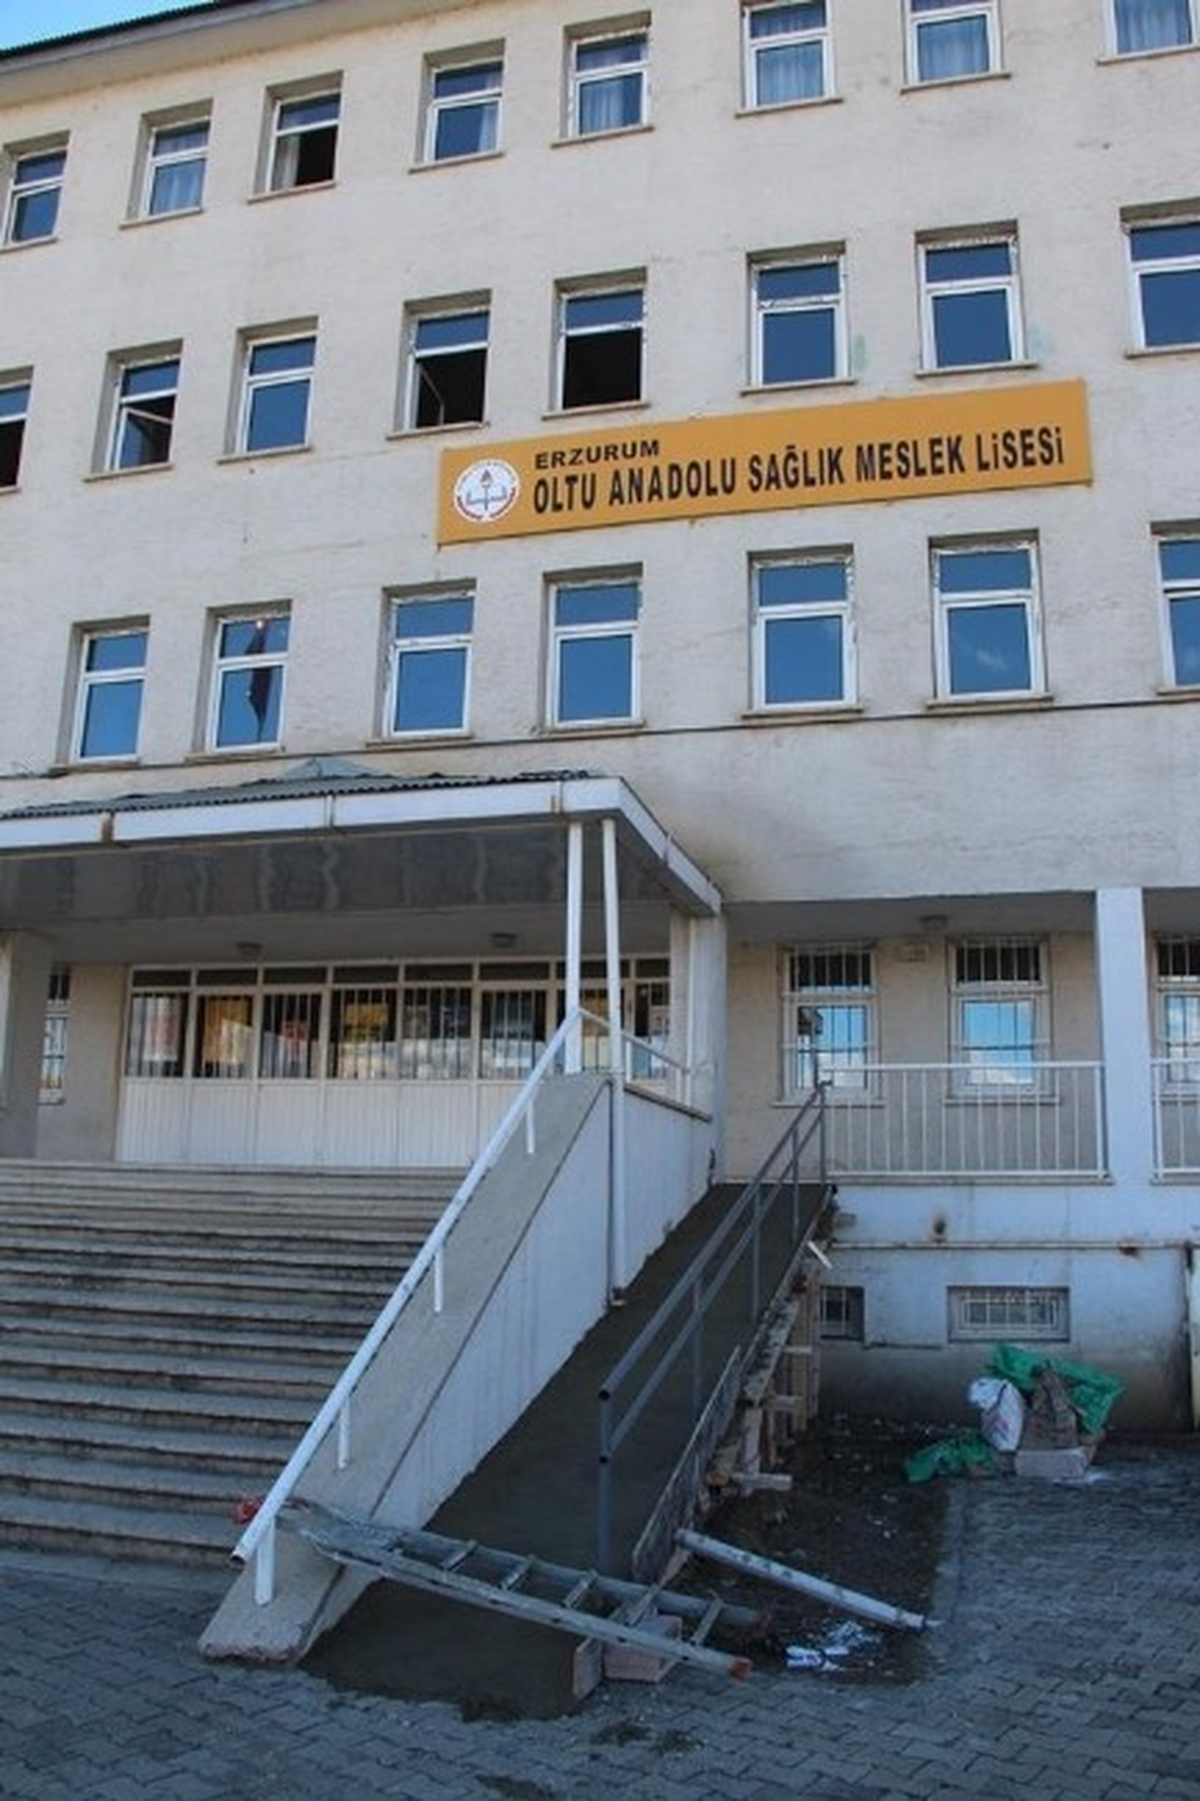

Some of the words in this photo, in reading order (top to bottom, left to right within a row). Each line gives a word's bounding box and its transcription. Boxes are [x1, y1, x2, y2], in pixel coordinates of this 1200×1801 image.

[533, 472, 597, 514] OLTU
[608, 457, 737, 506] ANADOLU
[748, 445, 845, 492] SAĞLIK
[856, 435, 966, 482] MESLEK
[534, 440, 660, 470] ERZURUM
